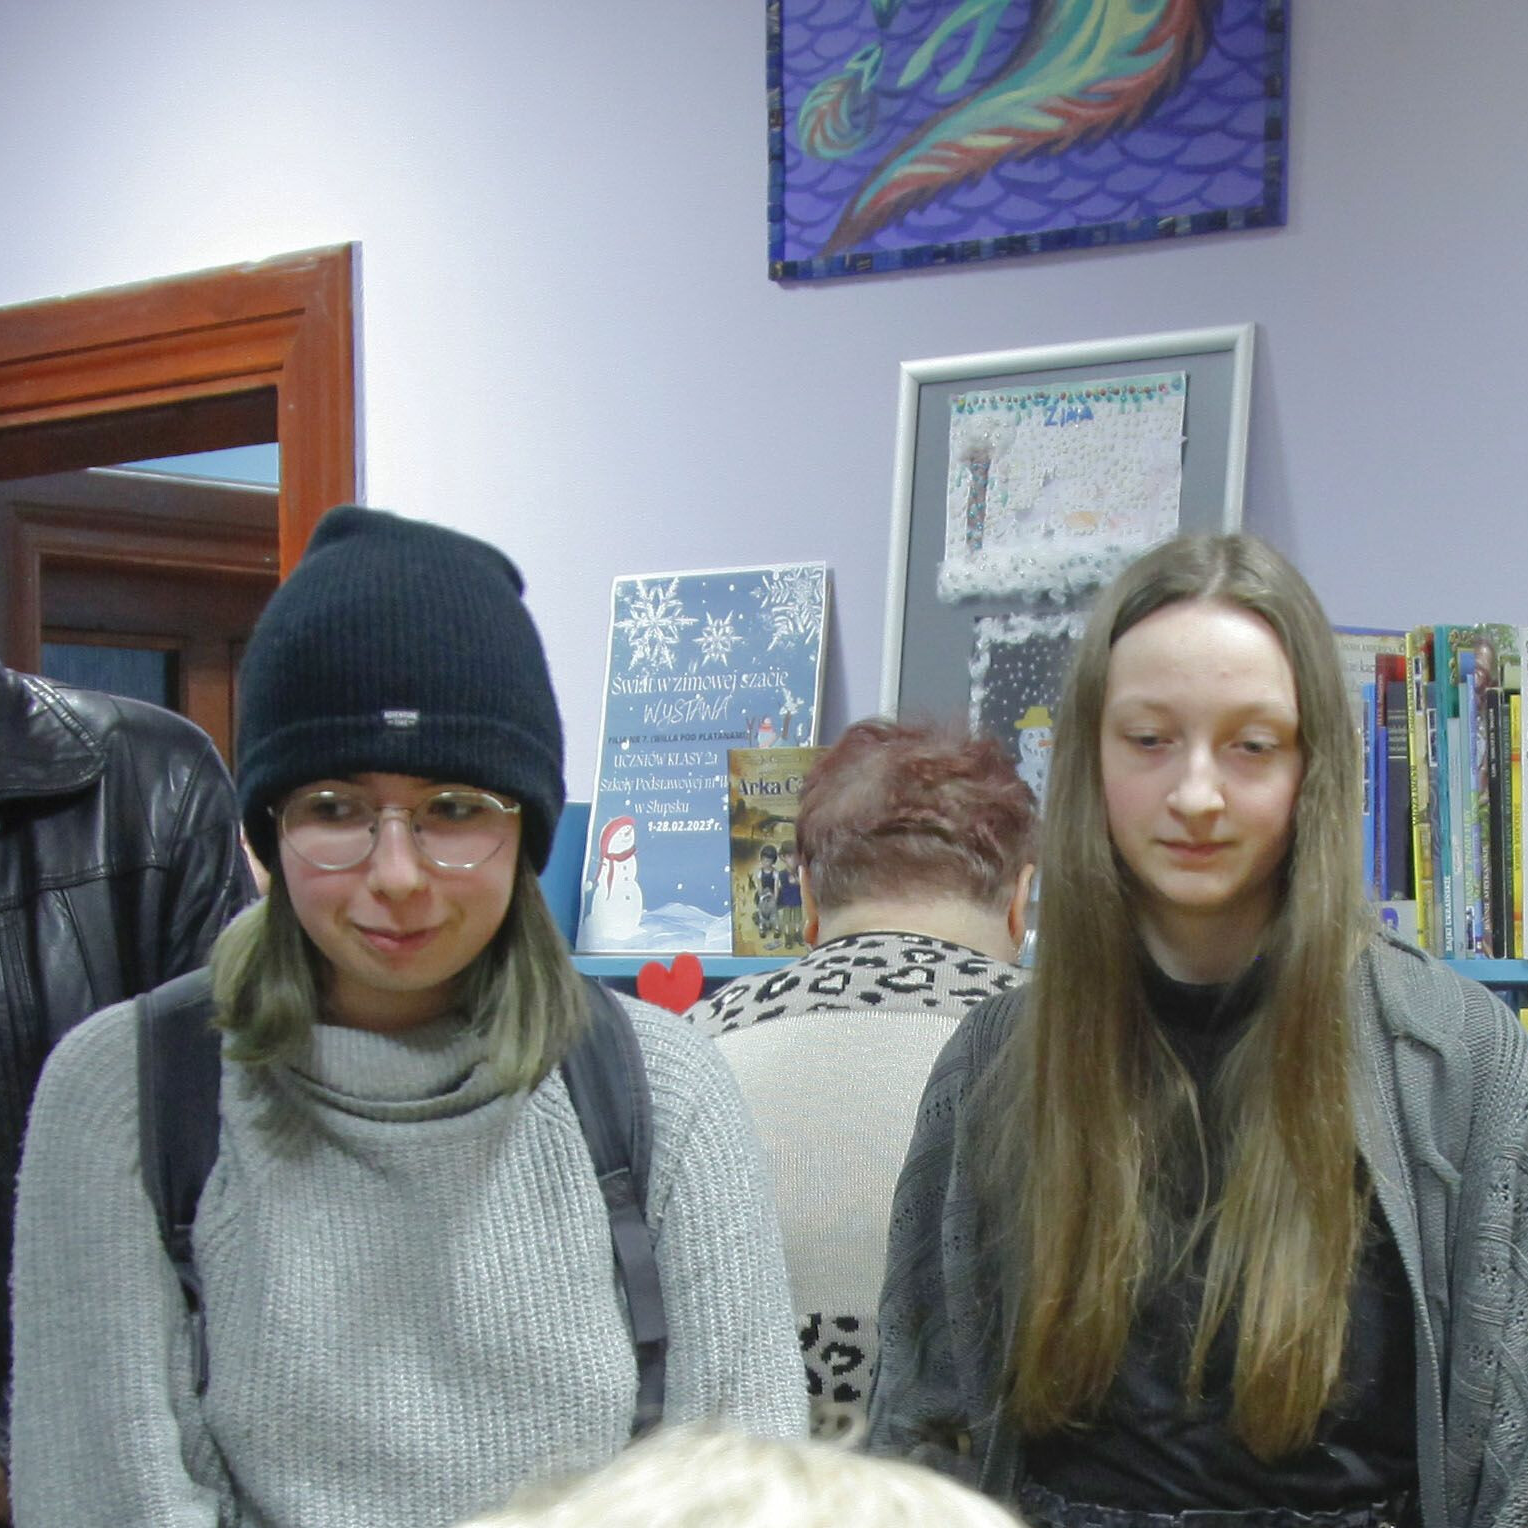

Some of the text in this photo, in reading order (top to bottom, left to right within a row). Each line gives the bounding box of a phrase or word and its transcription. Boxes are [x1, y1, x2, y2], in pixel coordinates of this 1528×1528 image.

[1044, 404, 1094, 427] ZIMA
[611, 671, 789, 697] Świat w zimowej szacie
[644, 695, 733, 726] WYSTAWA
[614, 752, 663, 767] UCZNIÓW
[668, 752, 701, 766] KLASY
[600, 777, 631, 794] Szkoły
[636, 776, 702, 792] Podstawowej
[739, 779, 780, 795] Arka
[646, 799, 689, 816] Słupsku
[648, 819, 712, 832] 1-28.02.2023
